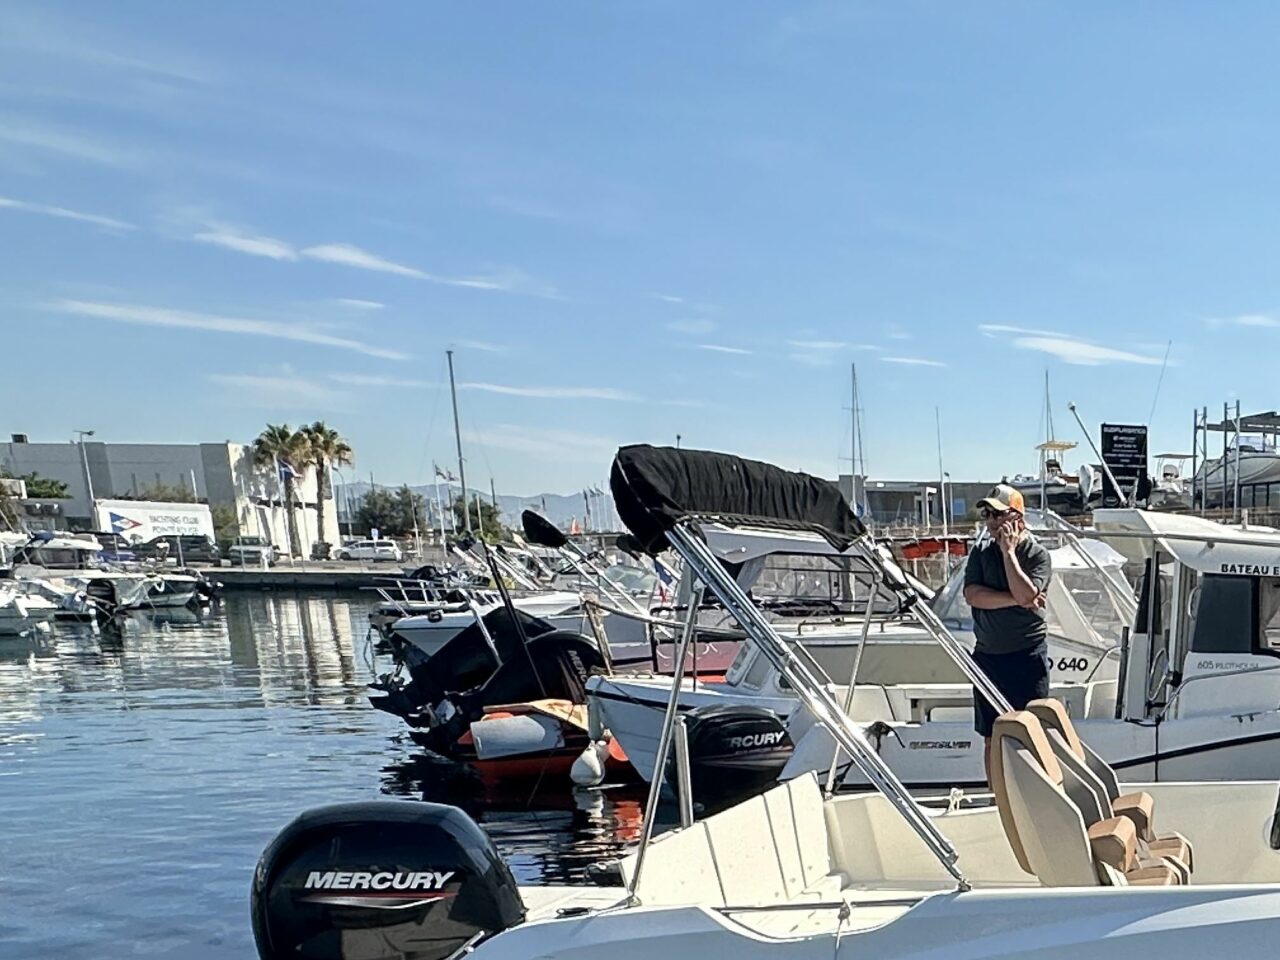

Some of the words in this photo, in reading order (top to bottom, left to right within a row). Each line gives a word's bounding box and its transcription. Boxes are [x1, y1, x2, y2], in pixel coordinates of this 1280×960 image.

[1221, 564, 1270, 575] BATEAU
[1057, 657, 1089, 671] 640
[1197, 660, 1214, 670] 605
[304, 871, 456, 889] MERCURY
